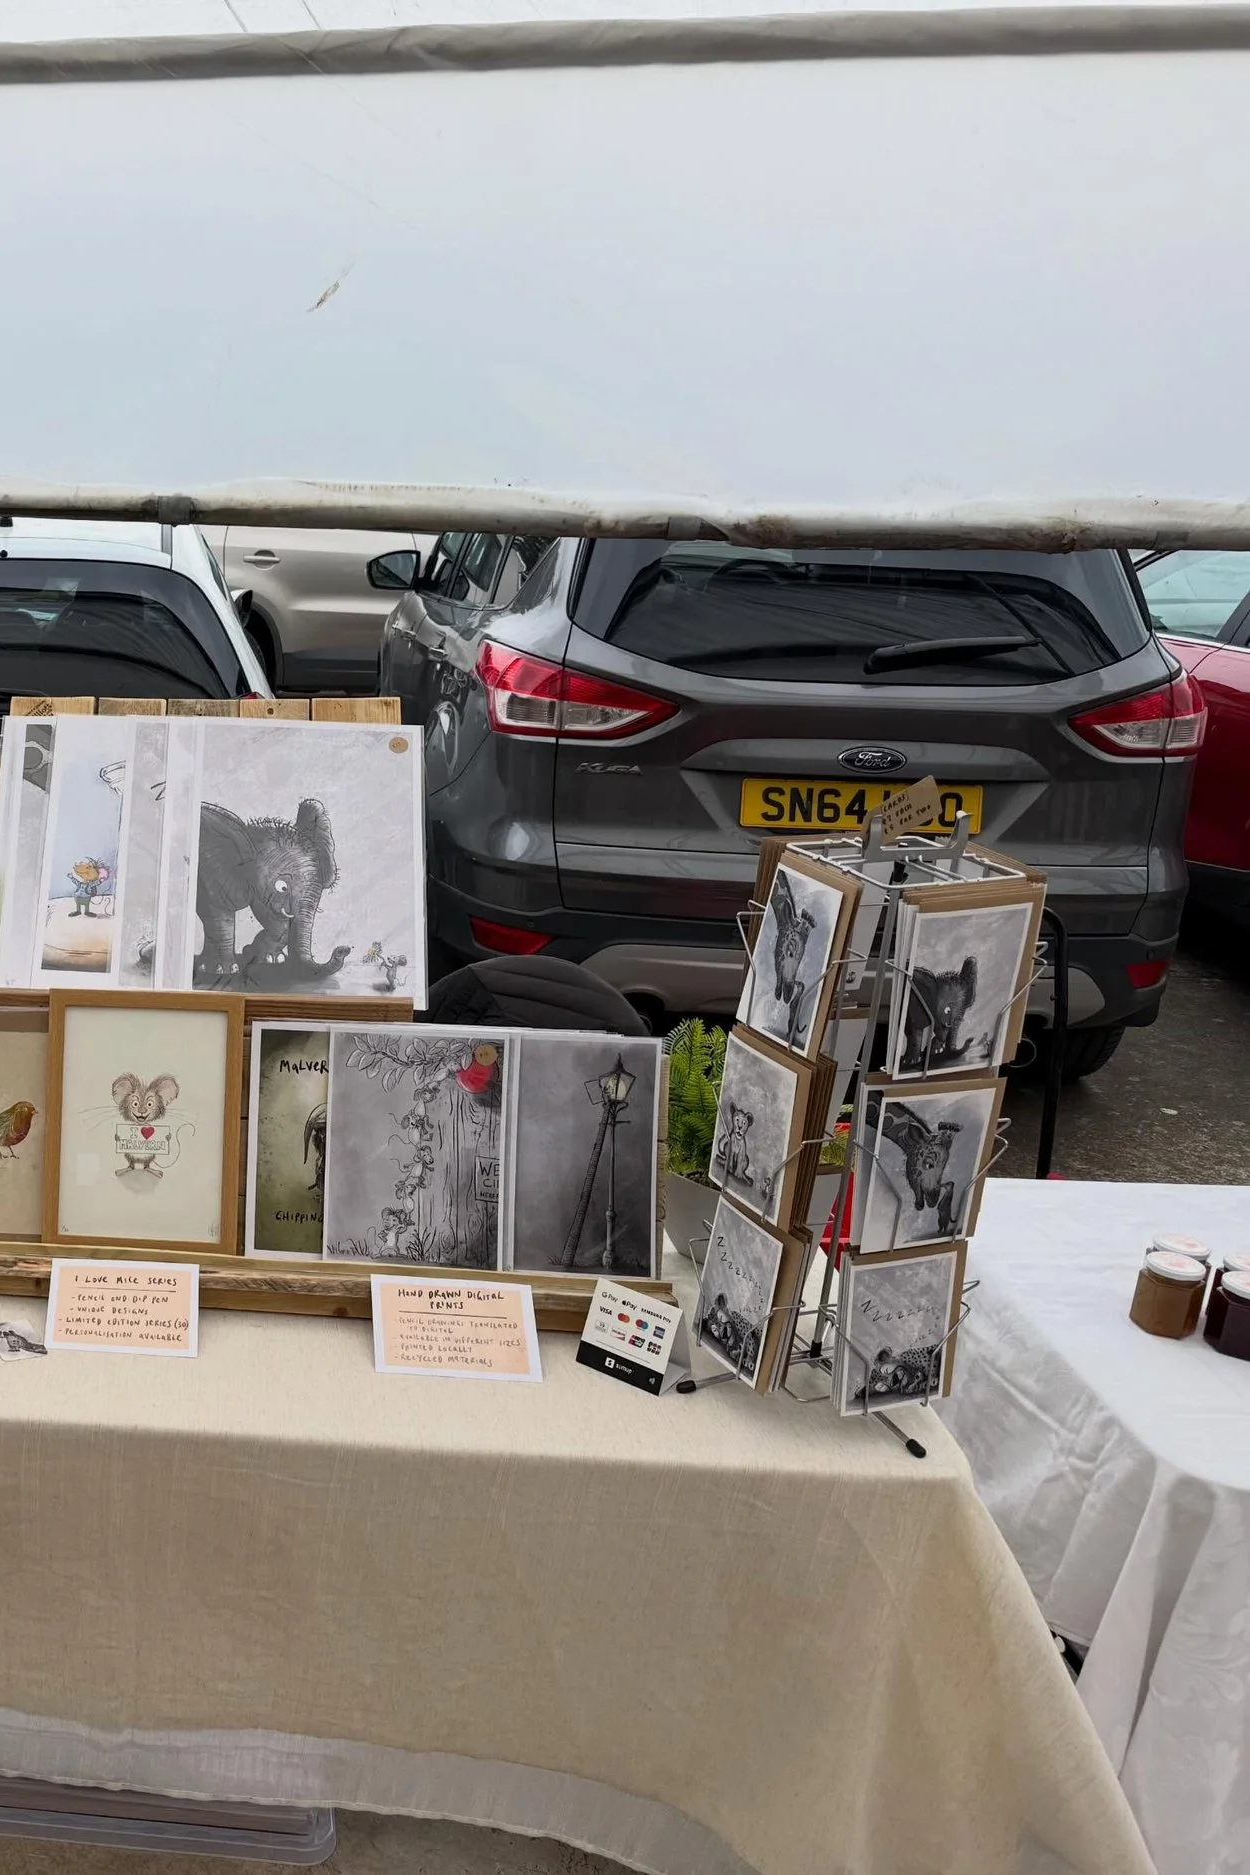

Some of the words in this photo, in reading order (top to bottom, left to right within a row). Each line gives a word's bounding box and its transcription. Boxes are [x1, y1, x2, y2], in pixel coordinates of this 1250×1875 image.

[855, 752, 891, 767] Ford
[761, 786, 867, 825] SN64
[85, 1276, 108, 1284] LOVE
[116, 1276, 139, 1285] MICE
[148, 1278, 177, 1287] SERIES
[78, 1294, 105, 1302] PENCIL
[111, 1295, 127, 1303] AND
[151, 1296, 169, 1304] PEN
[398, 1289, 423, 1298] HAND
[428, 1290, 461, 1300] DRAWN
[467, 1291, 505, 1301] DIGITAL
[112, 1307, 149, 1315] DESIGNS
[430, 1301, 464, 1310] PRINTS
[599, 1306, 613, 1316] VISA
[66, 1317, 102, 1326] LIMITED
[107, 1318, 141, 1327] EDITION
[145, 1319, 172, 1328] SERIES
[428, 1318, 464, 1327] DRAWINGS
[65, 1328, 133, 1339] PERSONALISATION
[139, 1333, 182, 1342] AVAILABLE
[400, 1334, 439, 1342] AVAILABLE
[455, 1337, 494, 1345] DIFFERENT
[401, 1355, 443, 1363] RECYCLED
[448, 1356, 493, 1368] MATERIALS
